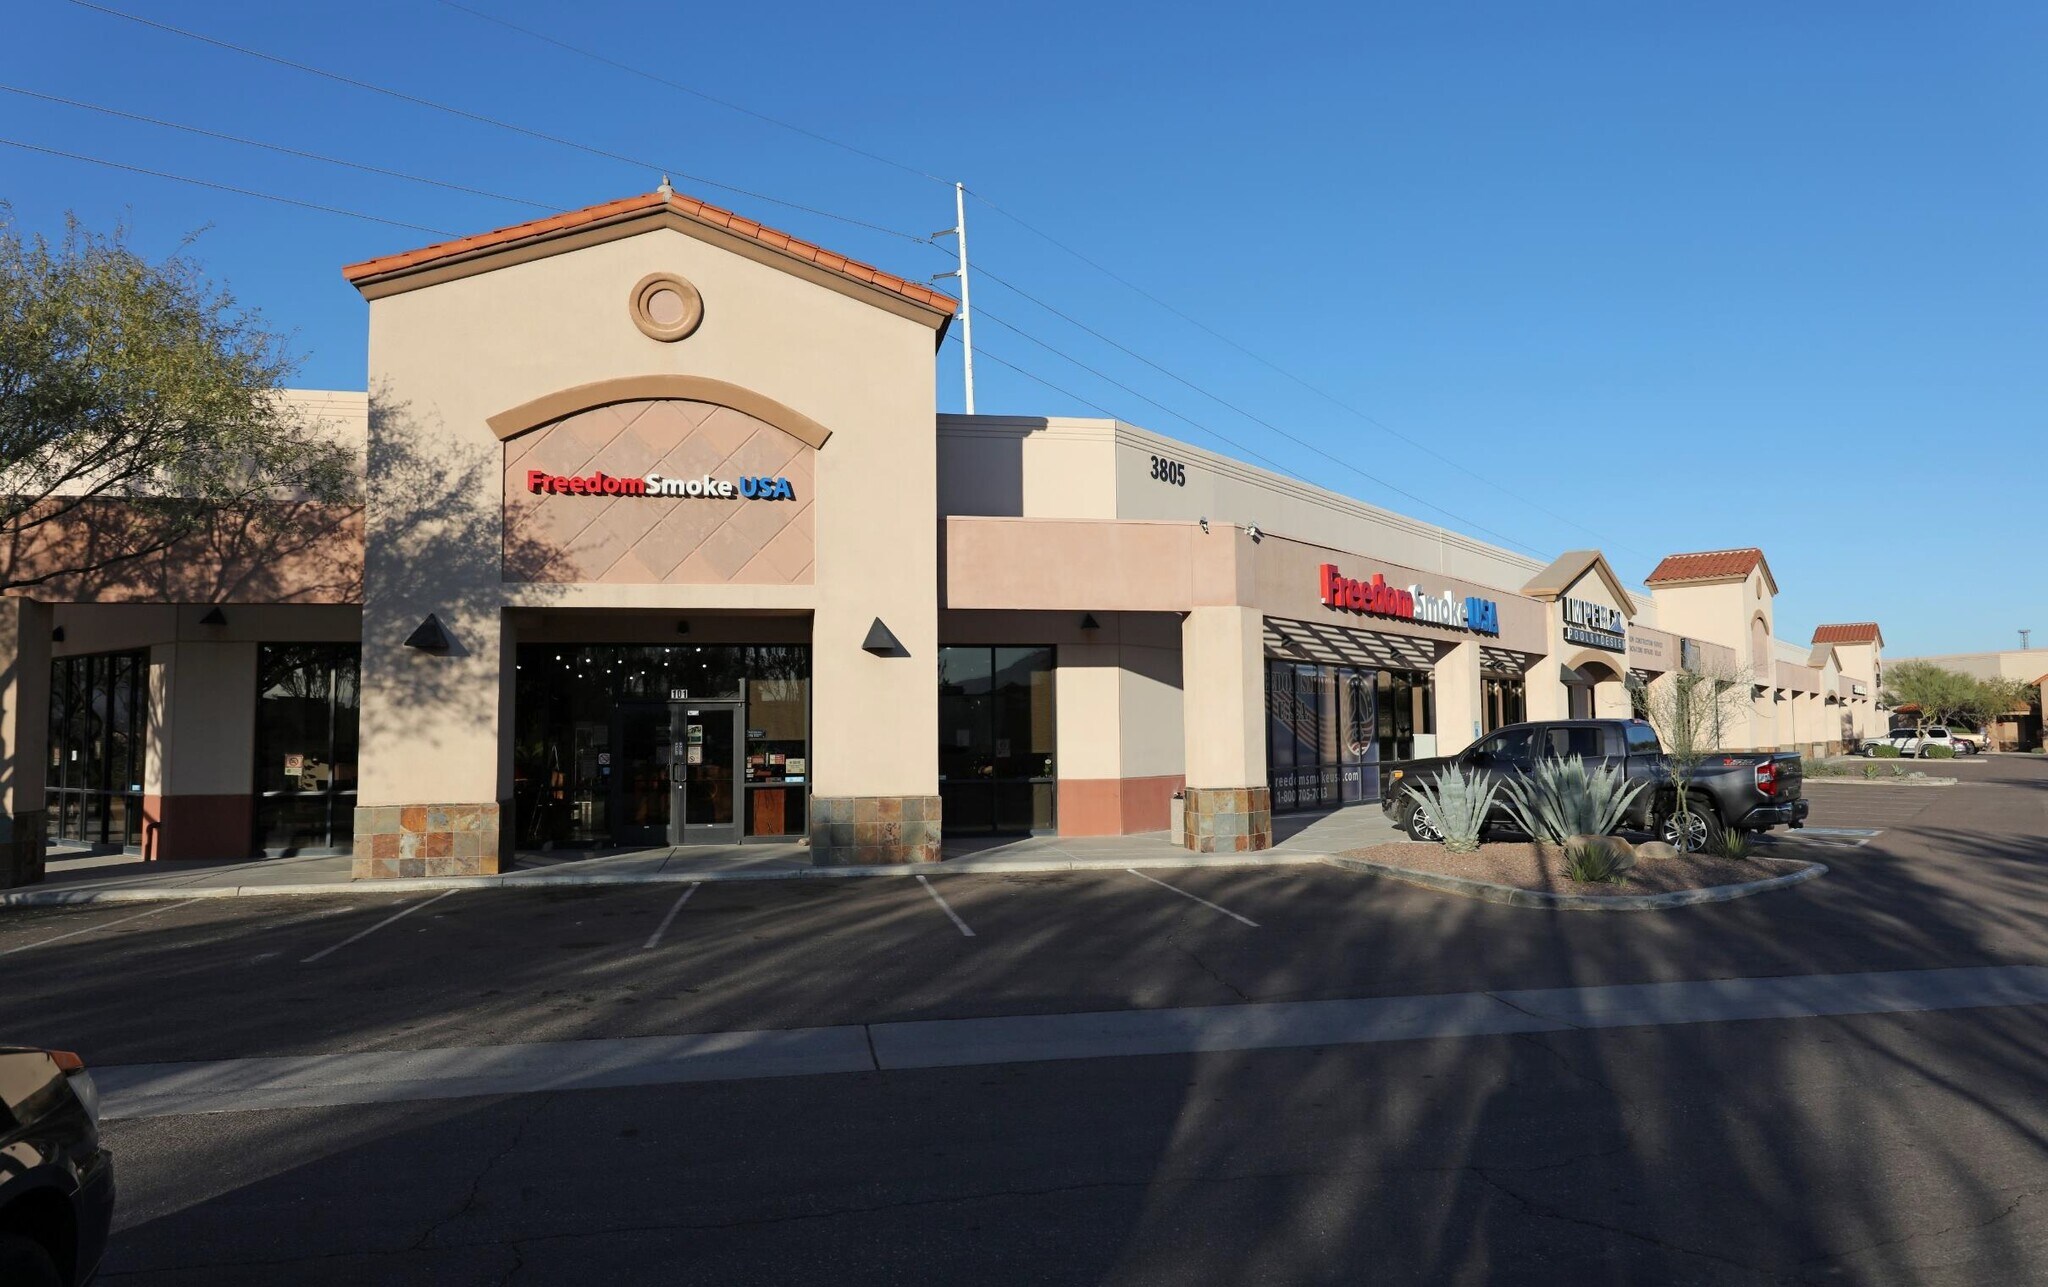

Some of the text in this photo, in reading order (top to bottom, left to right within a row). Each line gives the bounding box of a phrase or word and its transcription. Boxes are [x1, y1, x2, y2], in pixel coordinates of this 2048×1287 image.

[1150, 455, 1186, 487] 3805
[739, 475, 793, 499] USA
[1465, 596, 1500, 634] USA
[671, 689, 688, 699] 101
